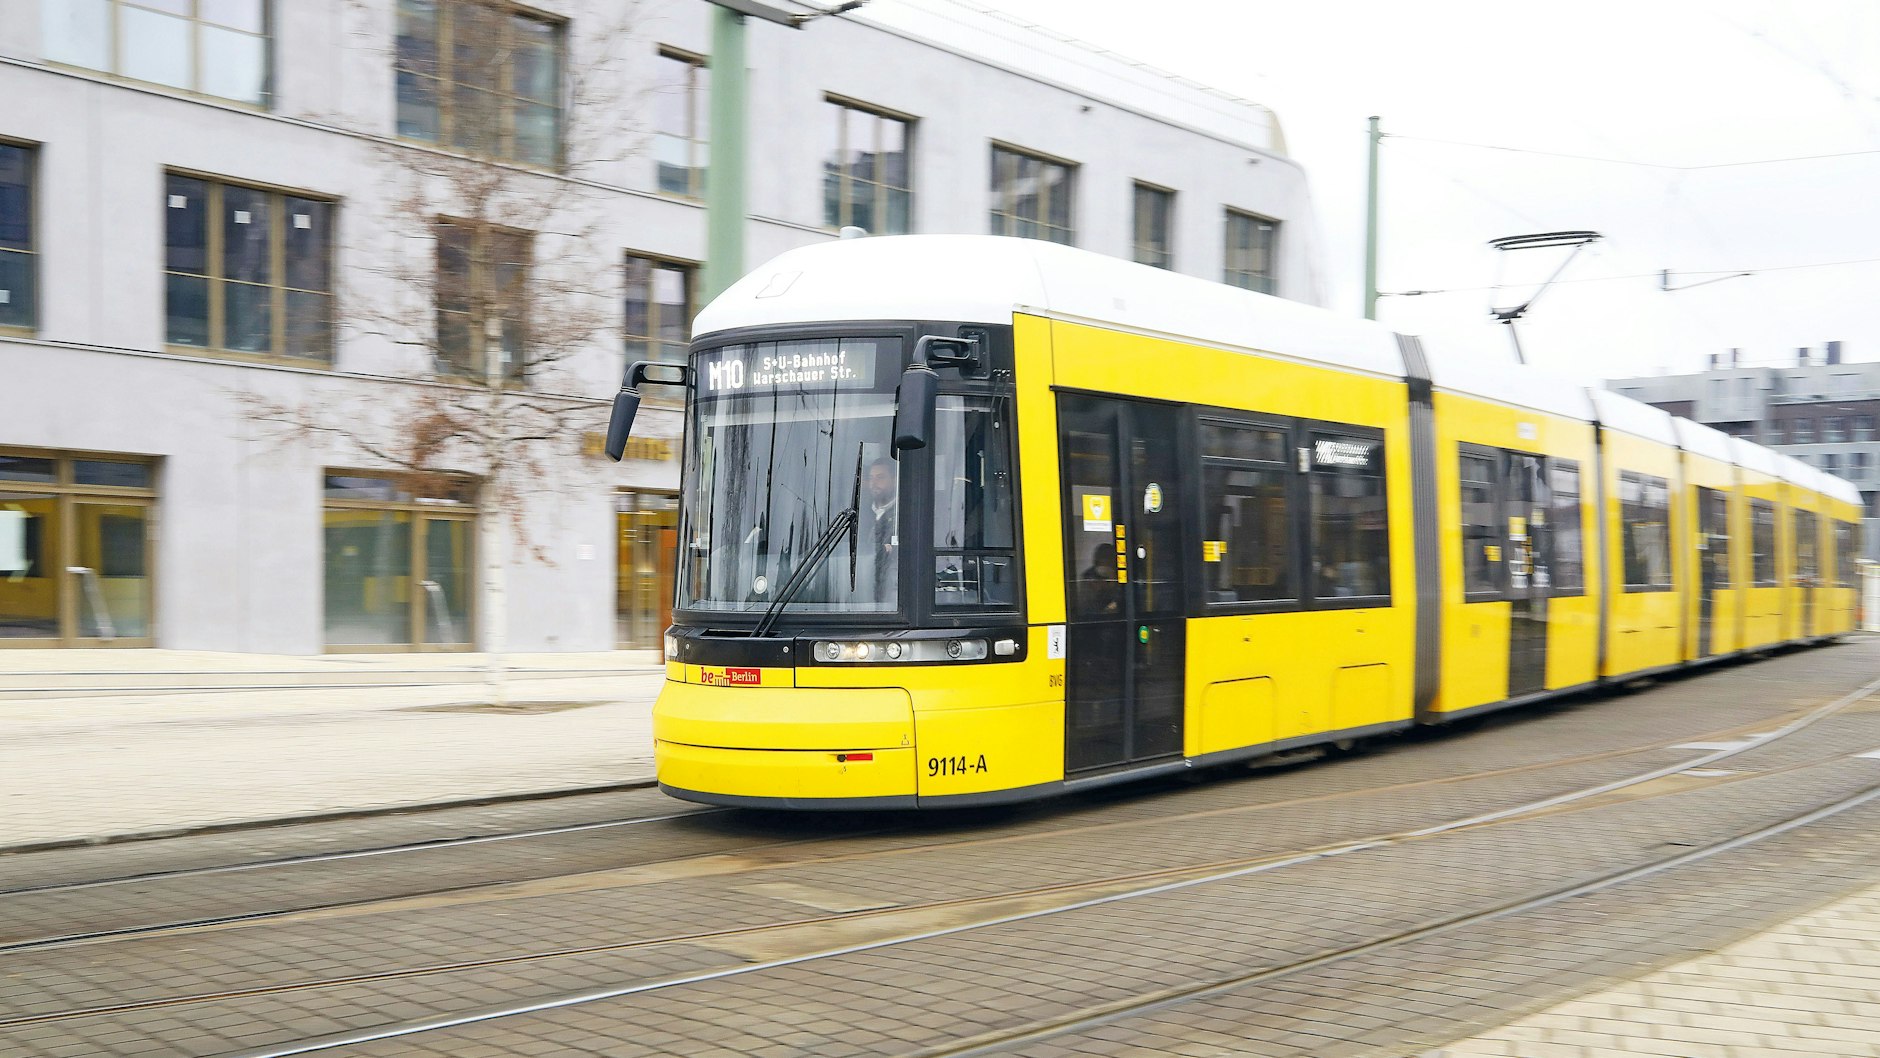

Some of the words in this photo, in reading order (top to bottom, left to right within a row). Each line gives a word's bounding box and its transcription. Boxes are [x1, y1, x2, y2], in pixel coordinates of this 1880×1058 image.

[763, 350, 846, 370] S+U-Bahnhof
[709, 359, 744, 391] M10
[753, 369, 825, 386] Warschauer
[830, 366, 857, 380] Str.
[701, 667, 714, 683] be
[731, 671, 758, 682] Berlin
[928, 754, 988, 777] 9114-A
